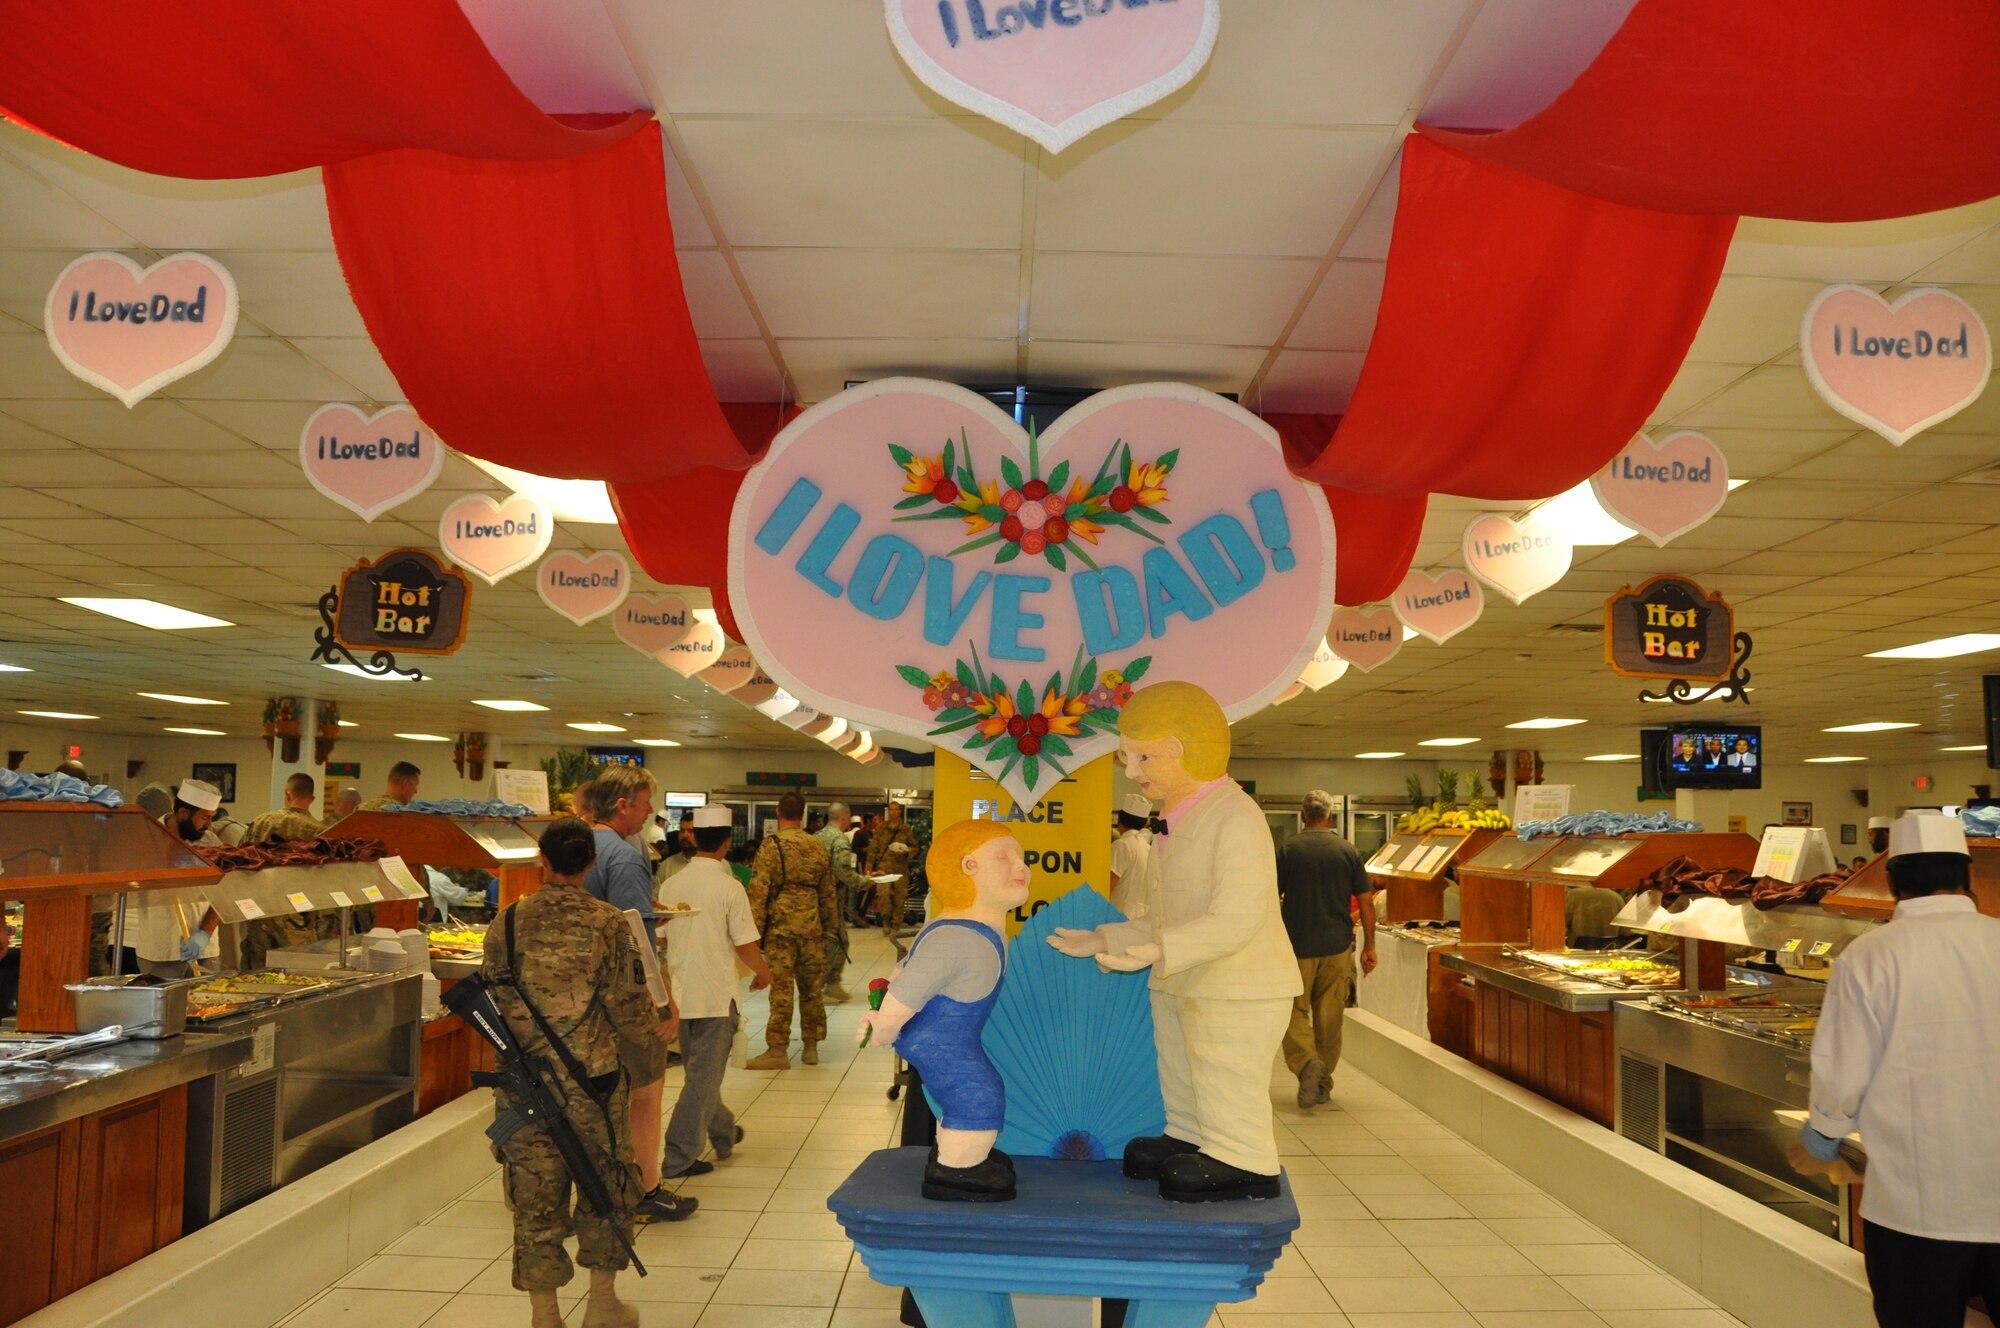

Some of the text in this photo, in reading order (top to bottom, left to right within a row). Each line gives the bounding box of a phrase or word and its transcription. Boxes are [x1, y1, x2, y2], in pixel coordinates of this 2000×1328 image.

[938, 0, 960, 47] I
[68, 290, 80, 322] I
[1834, 324, 1842, 356] I
[318, 435, 325, 460] I
[1612, 457, 1617, 479] I
[456, 520, 461, 539] I
[1474, 540, 1481, 560] I
[551, 570, 556, 586] I
[754, 477, 1296, 662] I LOVE DAD!
[378, 581, 430, 607] Hot
[1405, 595, 1411, 611] I
[374, 608, 431, 634] Bar
[627, 608, 632, 623] I
[1645, 603, 1697, 628] Hot
[1643, 631, 1700, 659] Bar
[971, 799, 1064, 824] PLACE
